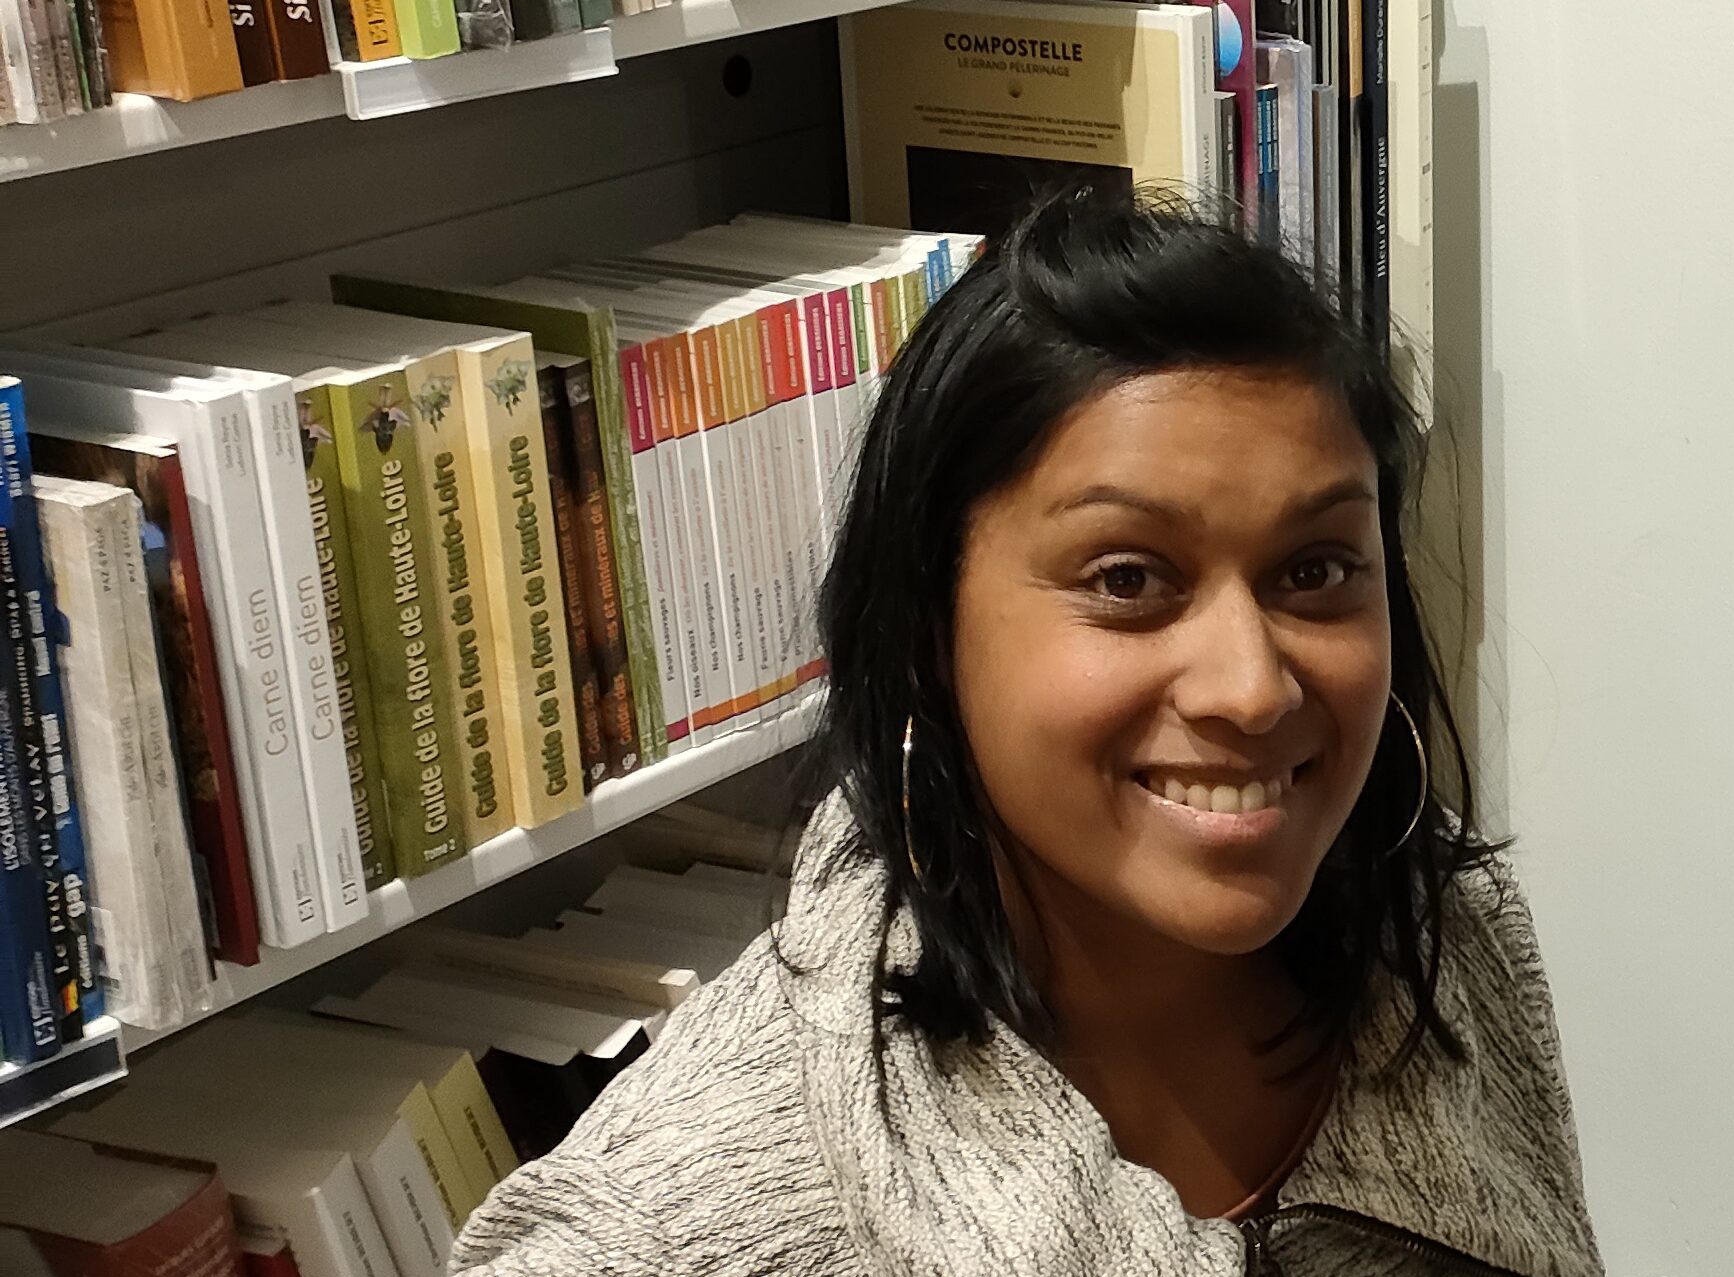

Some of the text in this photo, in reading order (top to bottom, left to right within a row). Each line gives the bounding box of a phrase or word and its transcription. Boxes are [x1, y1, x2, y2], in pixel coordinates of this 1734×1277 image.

[944, 33, 1083, 62] COMPOSTELLE
[957, 57, 970, 69] LE
[972, 59, 1007, 71] GRAND
[249, 588, 289, 757] Carne diem
[297, 575, 336, 741] Carne diem
[380, 459, 448, 834] Guide de la flore de Haute-Loire
[433, 451, 497, 819] Guide de la flore de Haute-Loire
[508, 434, 567, 797] Guide de la flore de Haute-Loire
